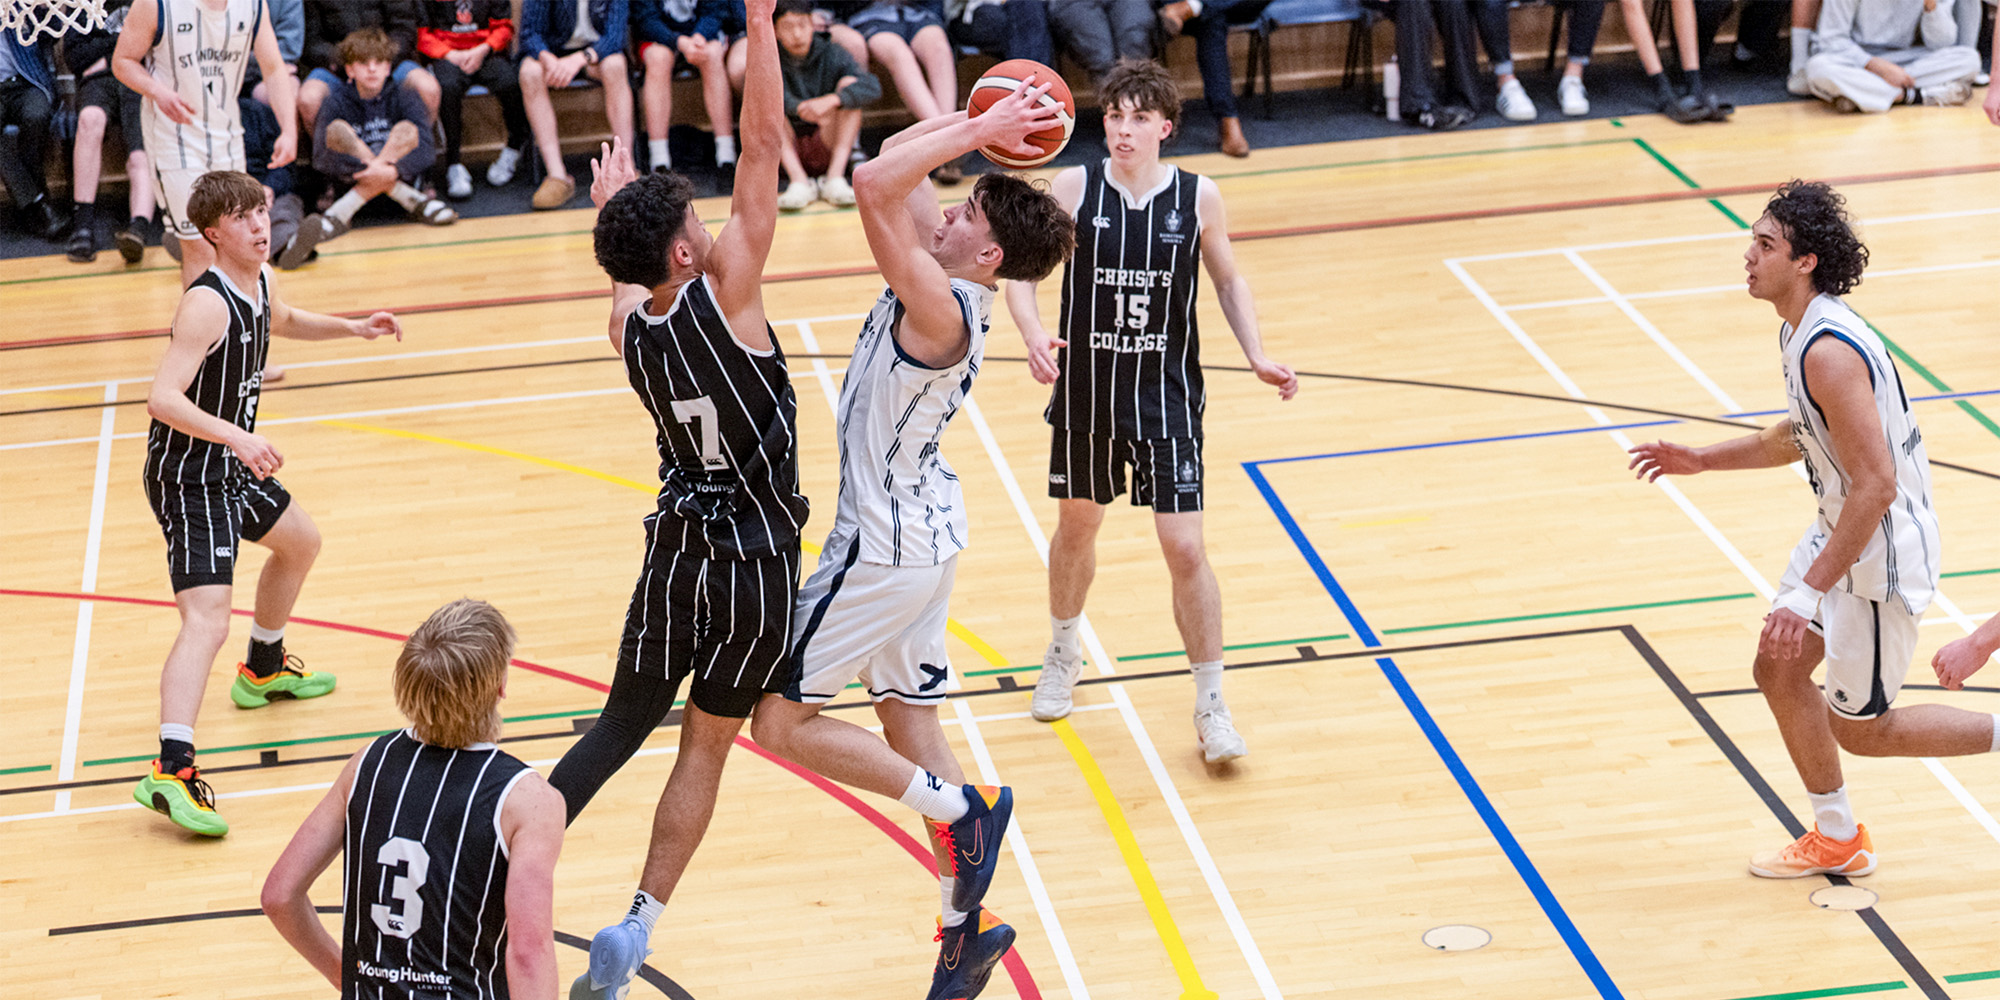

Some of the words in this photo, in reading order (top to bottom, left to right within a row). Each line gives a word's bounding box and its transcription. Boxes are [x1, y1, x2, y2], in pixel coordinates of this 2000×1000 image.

[1094, 267, 1173, 288] CHRIST'S
[1114, 293, 1151, 329] 15
[1089, 332, 1168, 353] COLLEGE
[670, 395, 730, 470] 7
[371, 836, 430, 940] 3
